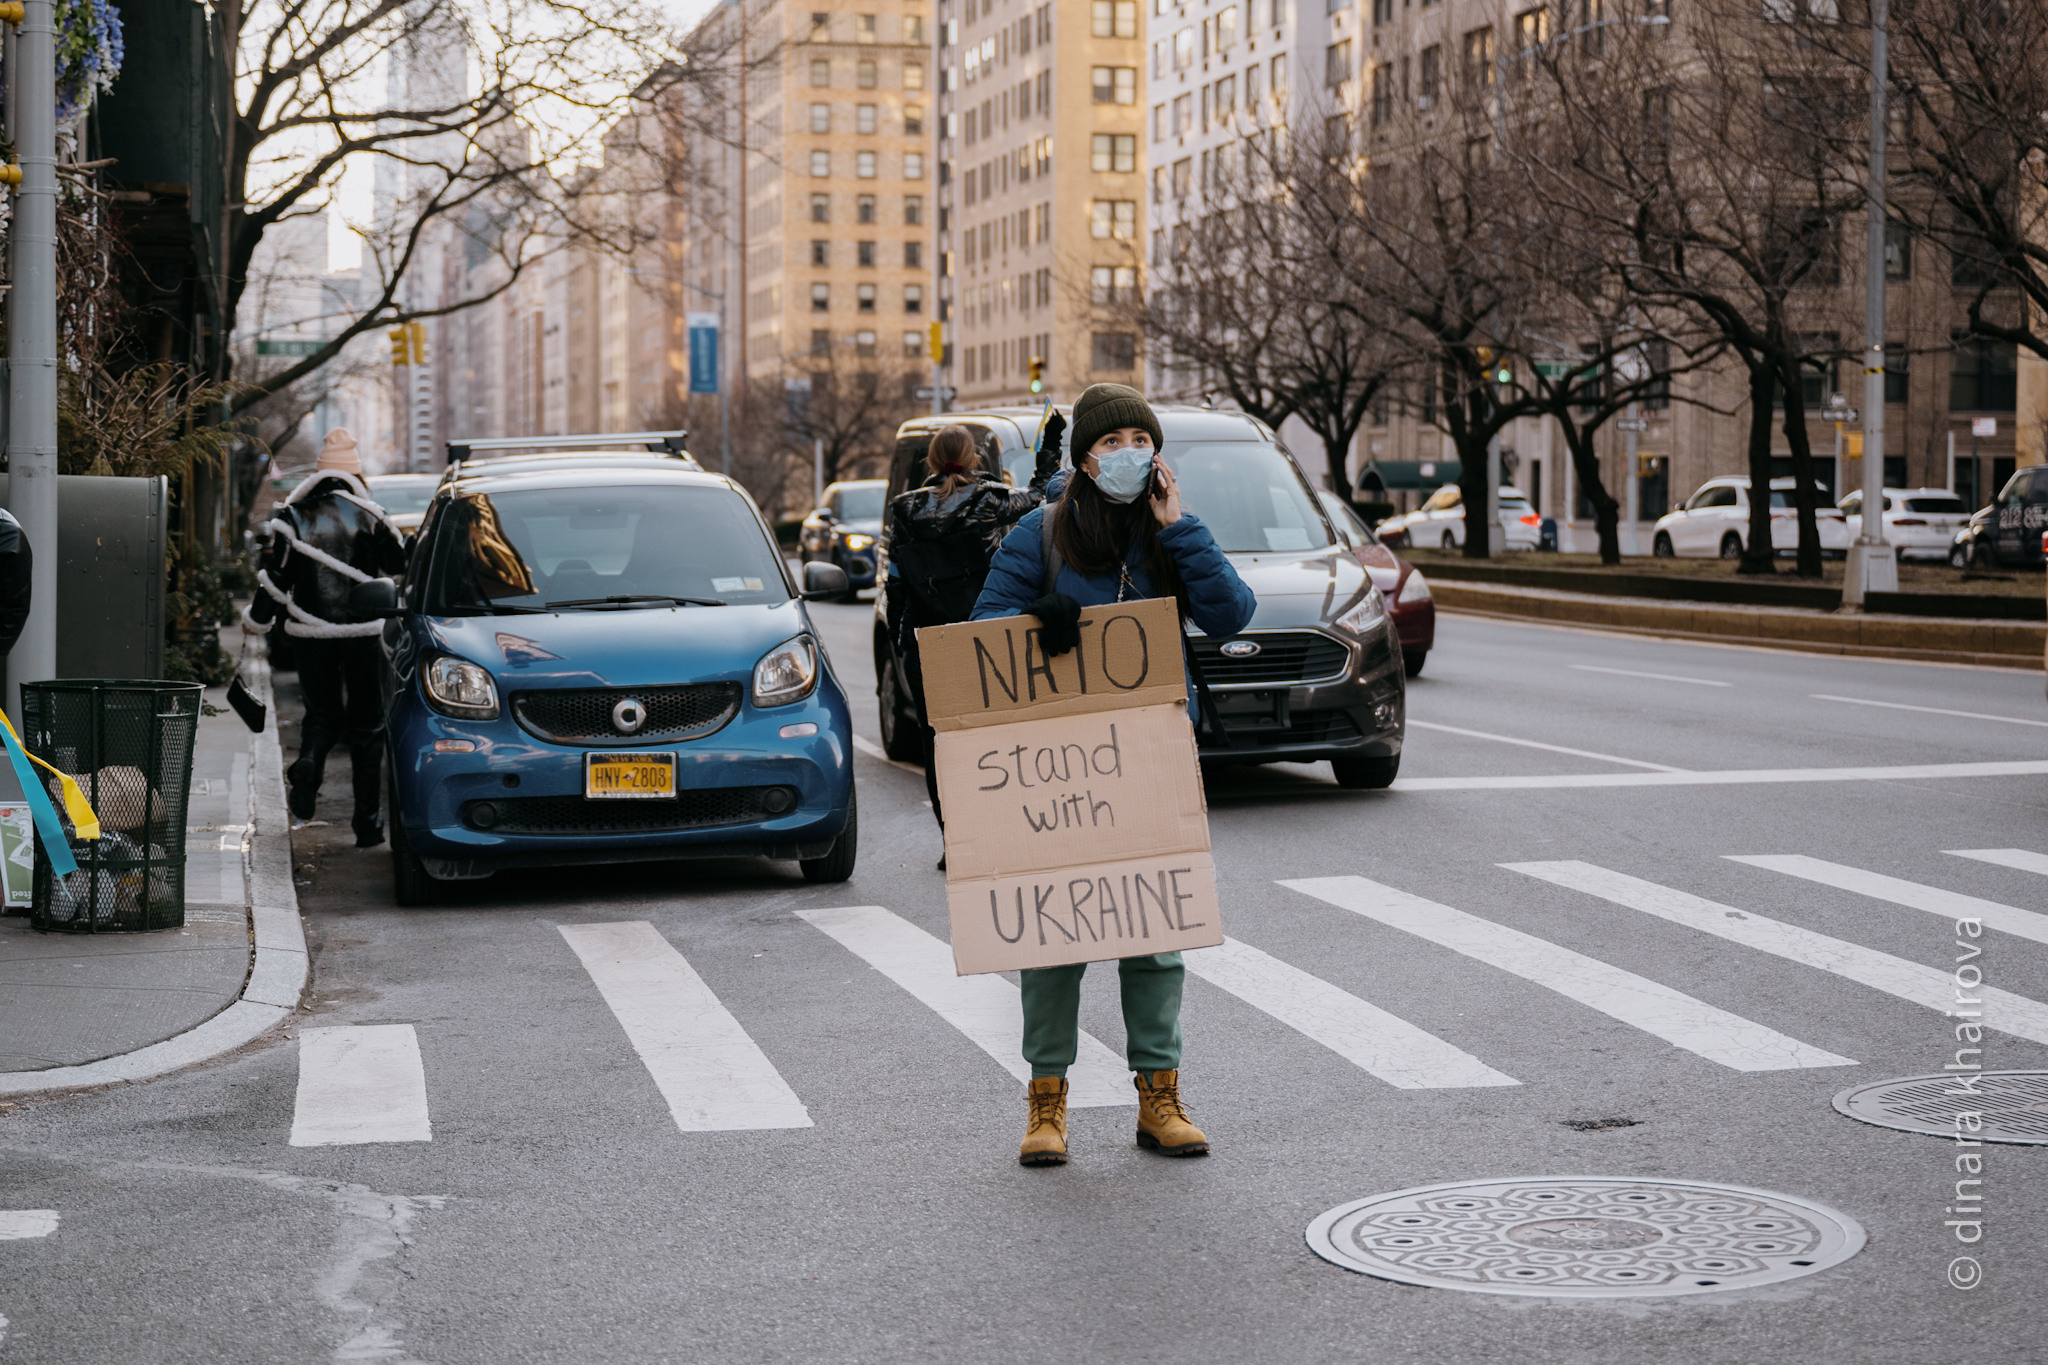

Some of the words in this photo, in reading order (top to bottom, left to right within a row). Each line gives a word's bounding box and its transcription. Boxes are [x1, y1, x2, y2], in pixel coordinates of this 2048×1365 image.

[973, 615, 1148, 708] NATO
[632, 766, 667, 788] 2808
[989, 867, 1205, 945] UKRAINE
